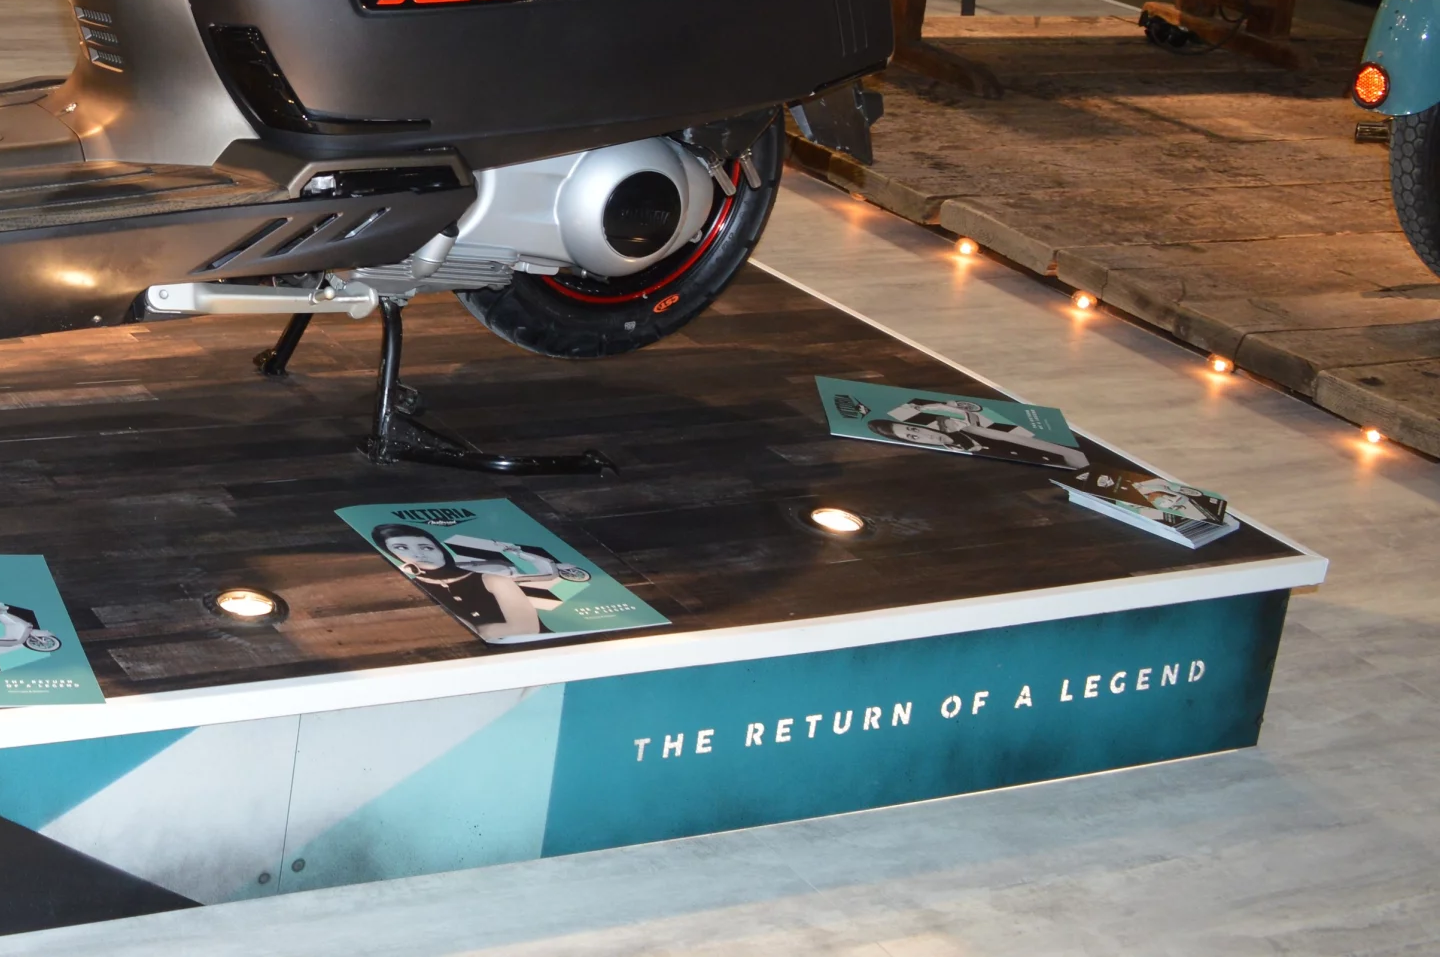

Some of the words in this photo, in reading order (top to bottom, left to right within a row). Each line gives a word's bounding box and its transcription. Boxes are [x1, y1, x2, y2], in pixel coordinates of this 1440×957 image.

[391, 508, 477, 521] VICTORIA
[633, 728, 715, 762] THE
[744, 702, 912, 747] RETURN
[940, 691, 989, 719] OF
[1014, 685, 1034, 709] A
[1060, 660, 1207, 703] LEGEND
